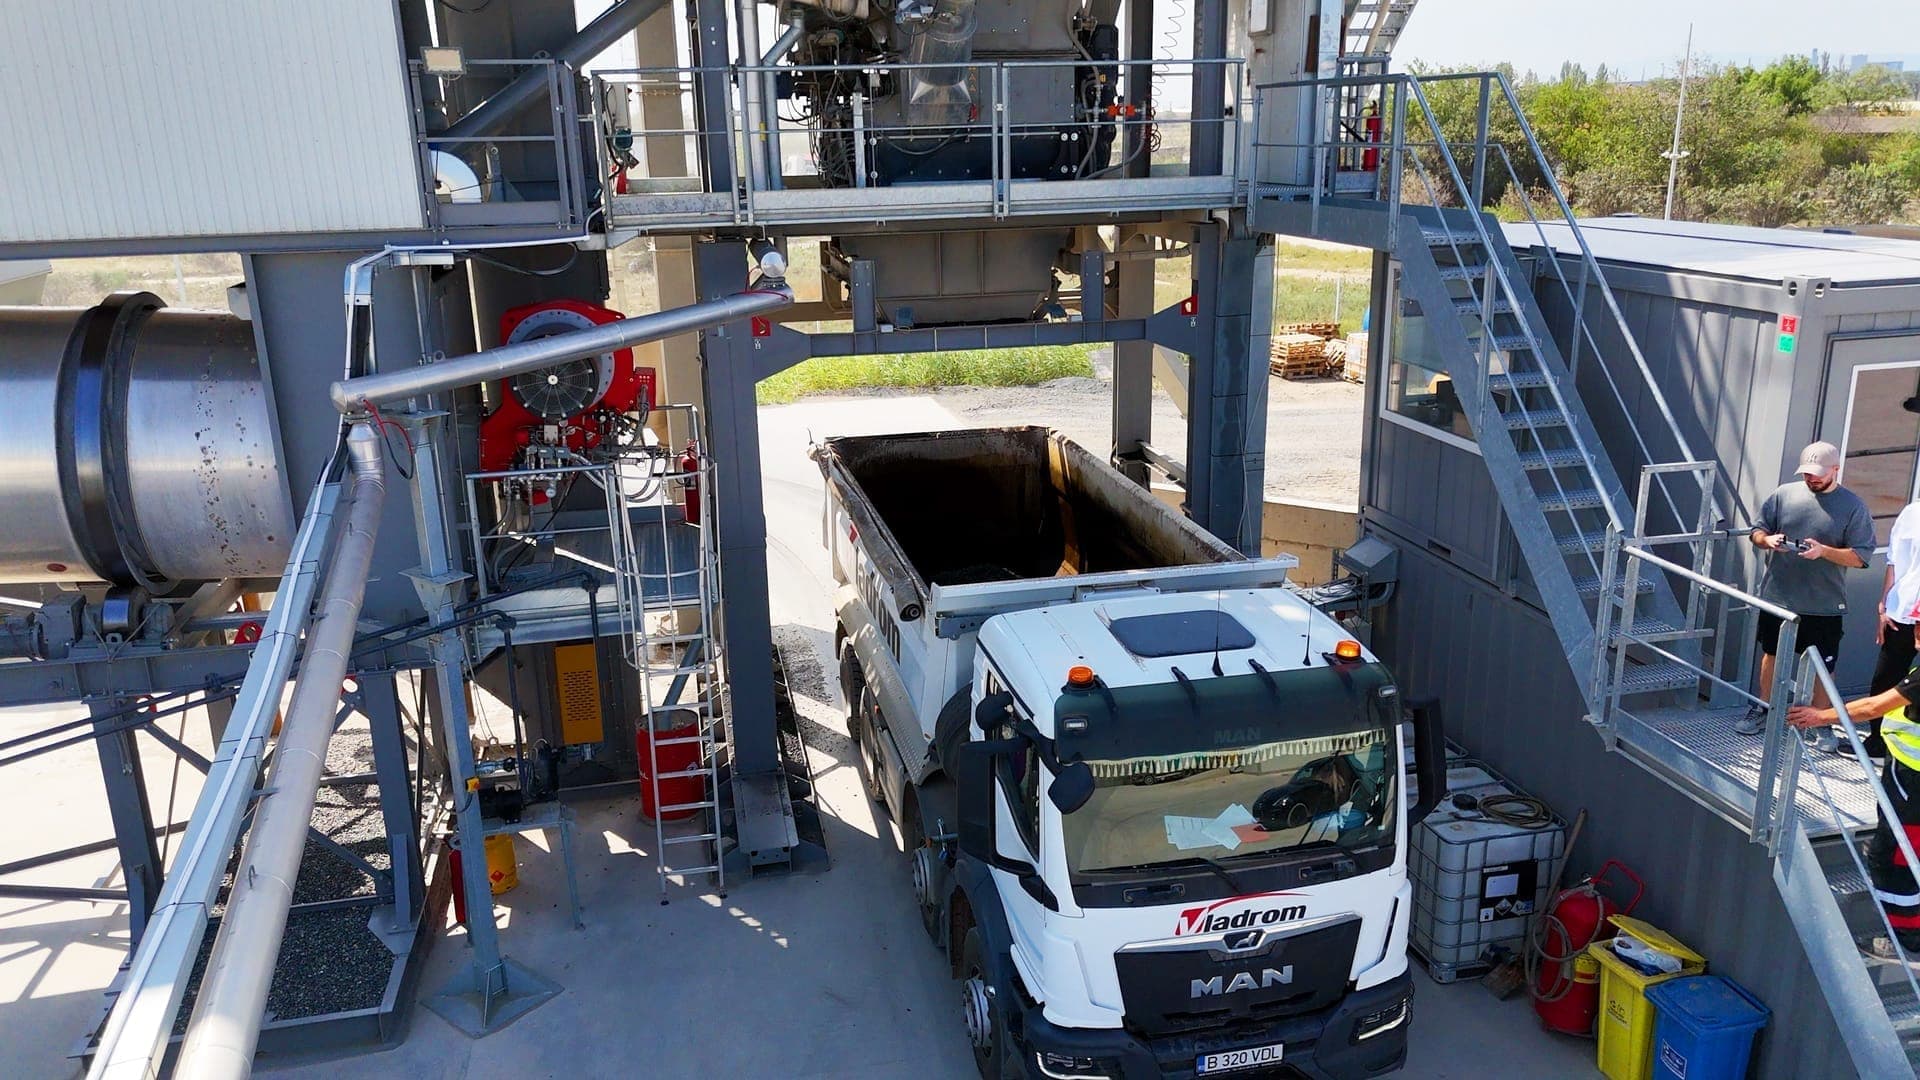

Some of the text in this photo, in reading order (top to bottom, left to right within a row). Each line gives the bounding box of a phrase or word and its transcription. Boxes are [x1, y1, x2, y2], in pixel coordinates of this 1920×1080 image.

[1215, 726, 1261, 745] MAN
[1174, 904, 1307, 936] Vladrom
[1190, 964, 1294, 999] MAN
[1207, 1056, 1218, 1069] B
[1222, 1051, 1248, 1067] 320
[1251, 1047, 1280, 1062] VDL
